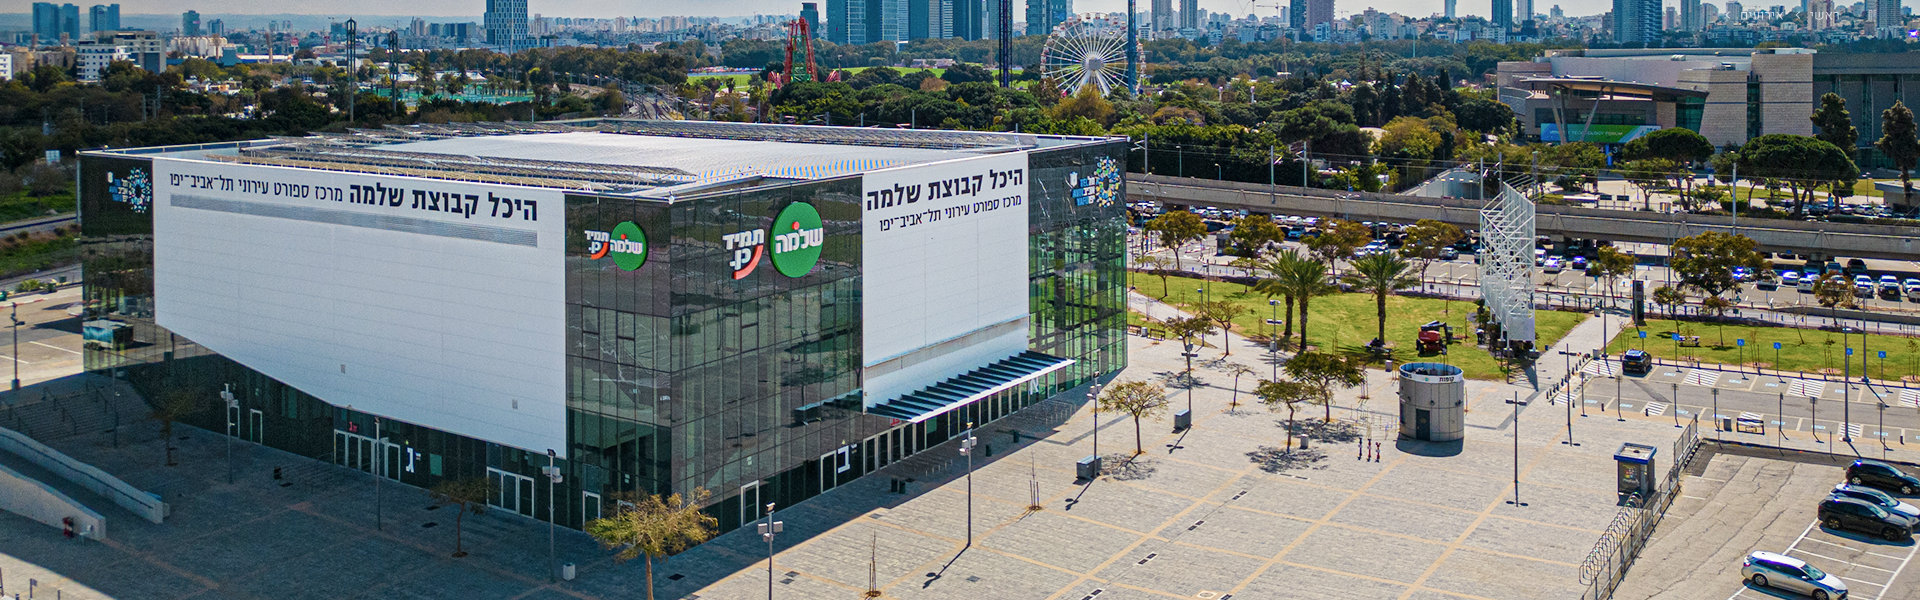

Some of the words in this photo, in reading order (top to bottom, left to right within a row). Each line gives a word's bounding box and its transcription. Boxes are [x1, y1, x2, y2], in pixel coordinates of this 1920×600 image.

[1612, 146, 1619, 154] 3
[238, 178, 269, 195] עירוני
[928, 174, 983, 201] קבוצת
[989, 168, 1023, 190] היכל
[274, 182, 310, 199] ספורט
[315, 185, 343, 202] מרכז
[349, 182, 405, 208] שלמה
[866, 182, 921, 211] שלמה
[1002, 195, 1022, 208] מרכז
[412, 189, 480, 219] קבוצת
[488, 191, 538, 221] היכל
[944, 204, 970, 219] עירוני
[973, 198, 1000, 214] ספורט
[584, 230, 610, 242] תמיד
[609, 239, 643, 255] שלמה
[722, 228, 765, 250] תמיד
[775, 228, 823, 254] שלמה
[405, 447, 415, 473] ג
[837, 445, 850, 473] ב
